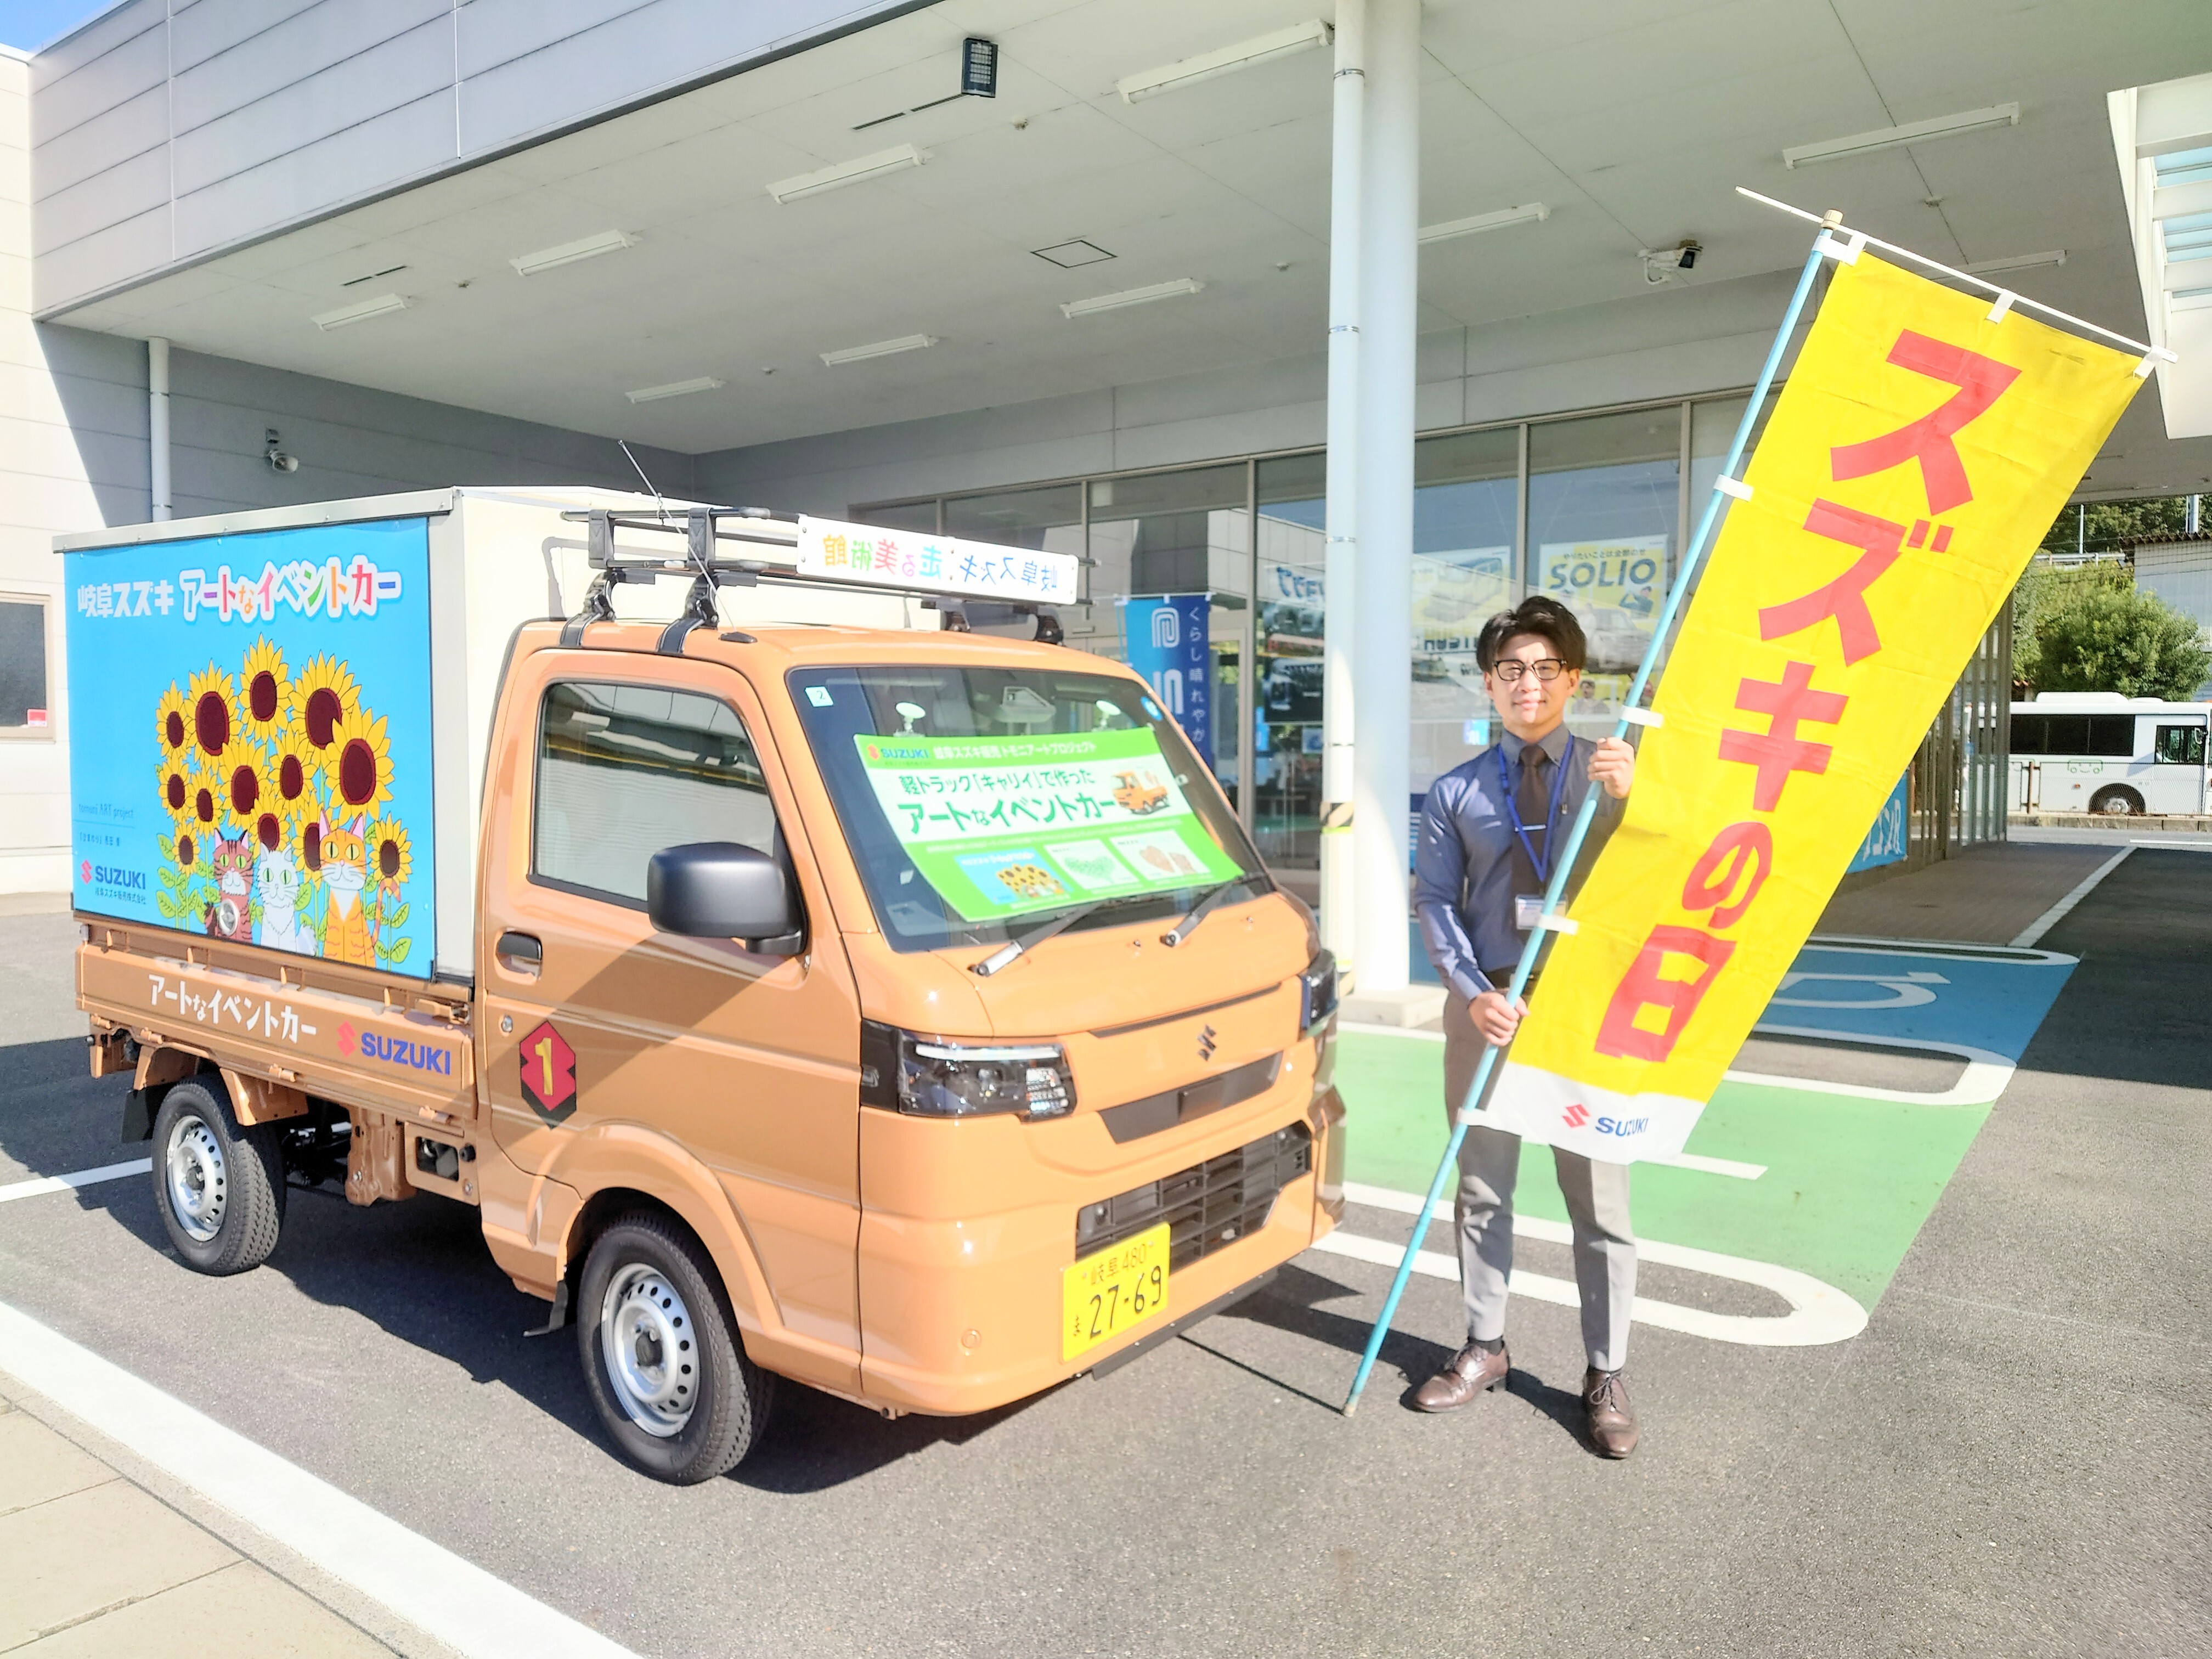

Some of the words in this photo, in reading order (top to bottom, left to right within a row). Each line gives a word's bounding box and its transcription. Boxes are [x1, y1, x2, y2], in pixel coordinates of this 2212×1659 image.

[77, 579, 174, 618] 岐阜スズキ
[180, 555, 401, 623] アートなイベントカー
[1549, 558, 1656, 589] SOLIO
[1188, 606, 1206, 752] くらし晴れやか
[1595, 330, 2022, 1063] スズキの日
[881, 748, 929, 759] SUZUKI
[899, 769, 1096, 795] 軽トラック「キャリイ」で作った
[897, 792, 1115, 834] アートなイベントカー
[95, 866, 145, 890] SUZUKI
[148, 974, 318, 1044] アートなイベントカー
[361, 1032, 451, 1076] SUZUKI
[1595, 1116, 1649, 1137] SUZUKI
[1122, 1243, 1147, 1272] 480
[1089, 1265, 1161, 1340] 27-69
